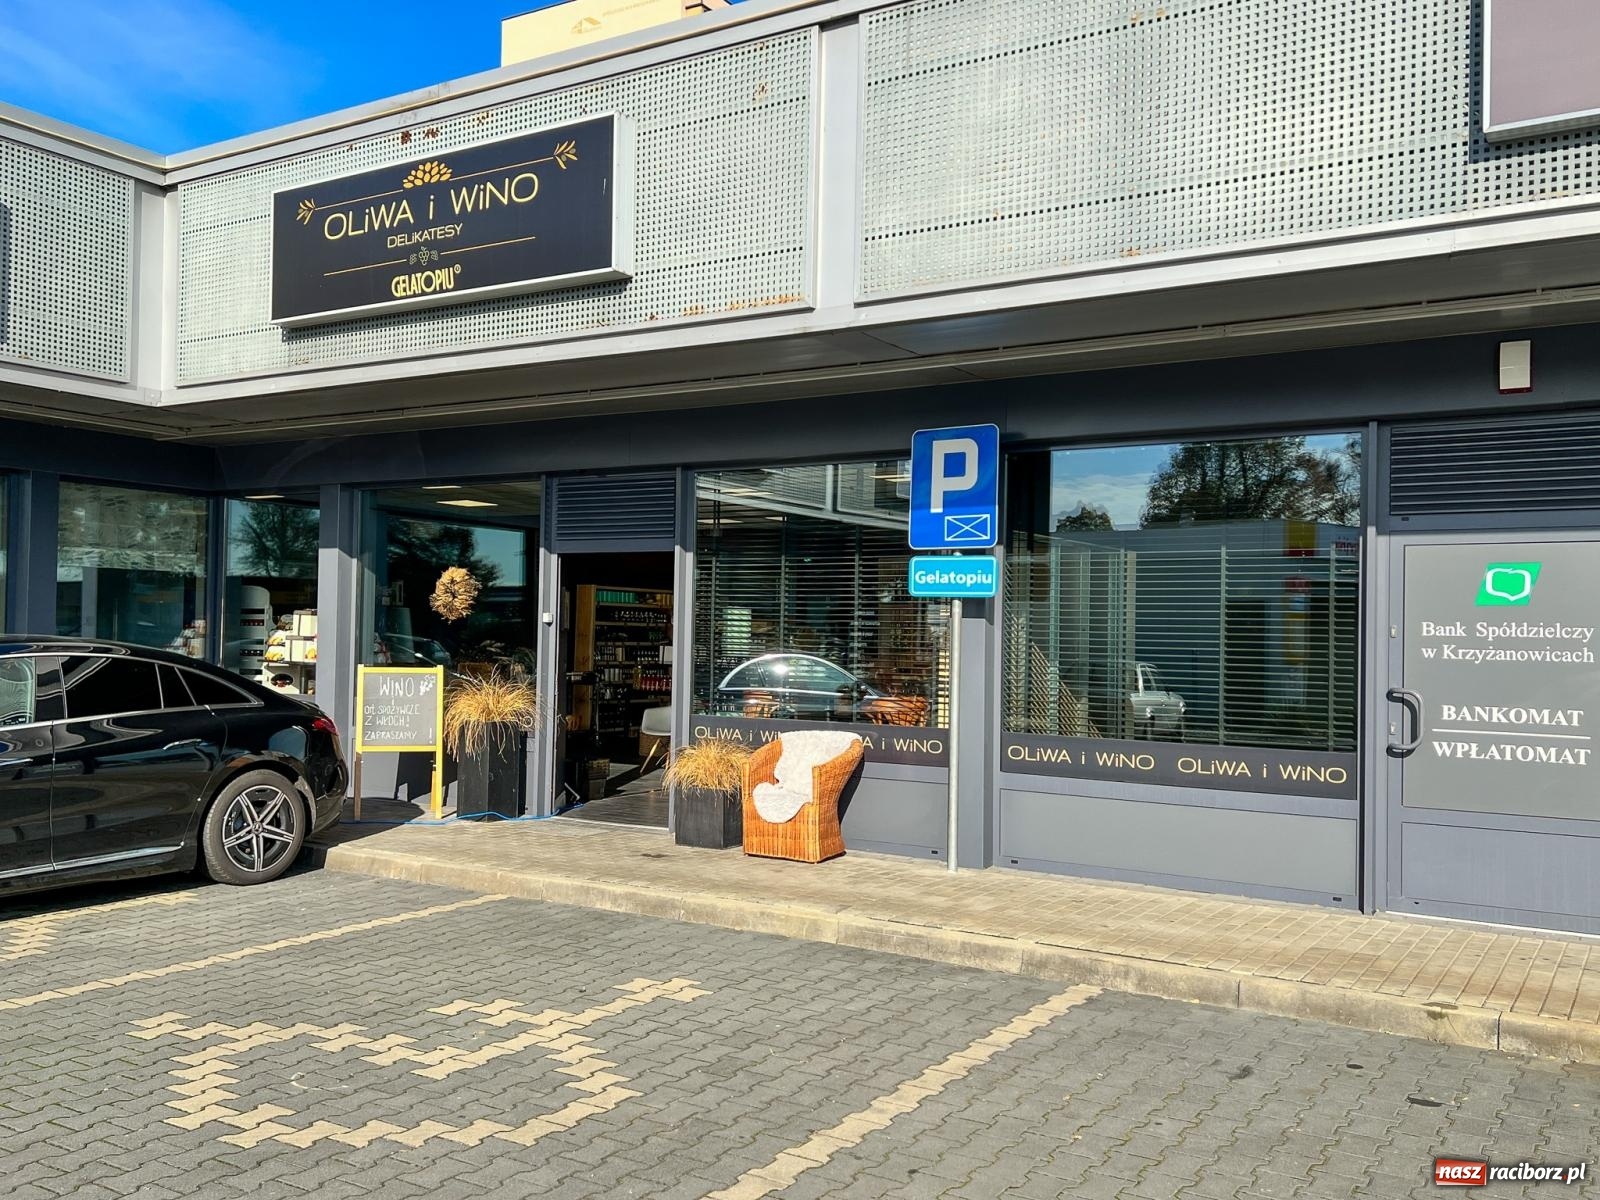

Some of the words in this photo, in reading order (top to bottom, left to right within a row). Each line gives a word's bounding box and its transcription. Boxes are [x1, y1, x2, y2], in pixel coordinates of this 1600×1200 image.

[324, 199, 414, 240] OLiWA
[428, 194, 435, 220] i
[450, 173, 539, 215] WiNO
[930, 437, 979, 514] P
[914, 570, 993, 588] Gelatopiu
[1421, 621, 1467, 637] Bank
[1476, 621, 1594, 643] Spółdzielczy
[1421, 647, 1437, 659] w
[1442, 644, 1595, 664] Krzyżanowicach
[379, 675, 415, 697] WINO
[1441, 704, 1584, 727] BANKOMAT
[364, 730, 417, 741] ZAPRASZAMY
[881, 737, 885, 751] i
[894, 738, 943, 754] WiNO
[1007, 745, 1072, 765] OLiWA
[1081, 751, 1086, 765] i
[1096, 752, 1155, 770] WiNO
[1177, 757, 1251, 777] OLiWA
[1263, 763, 1267, 779] i
[1279, 764, 1347, 784] WiNO
[1432, 741, 1591, 766] WPŁATOMAT
